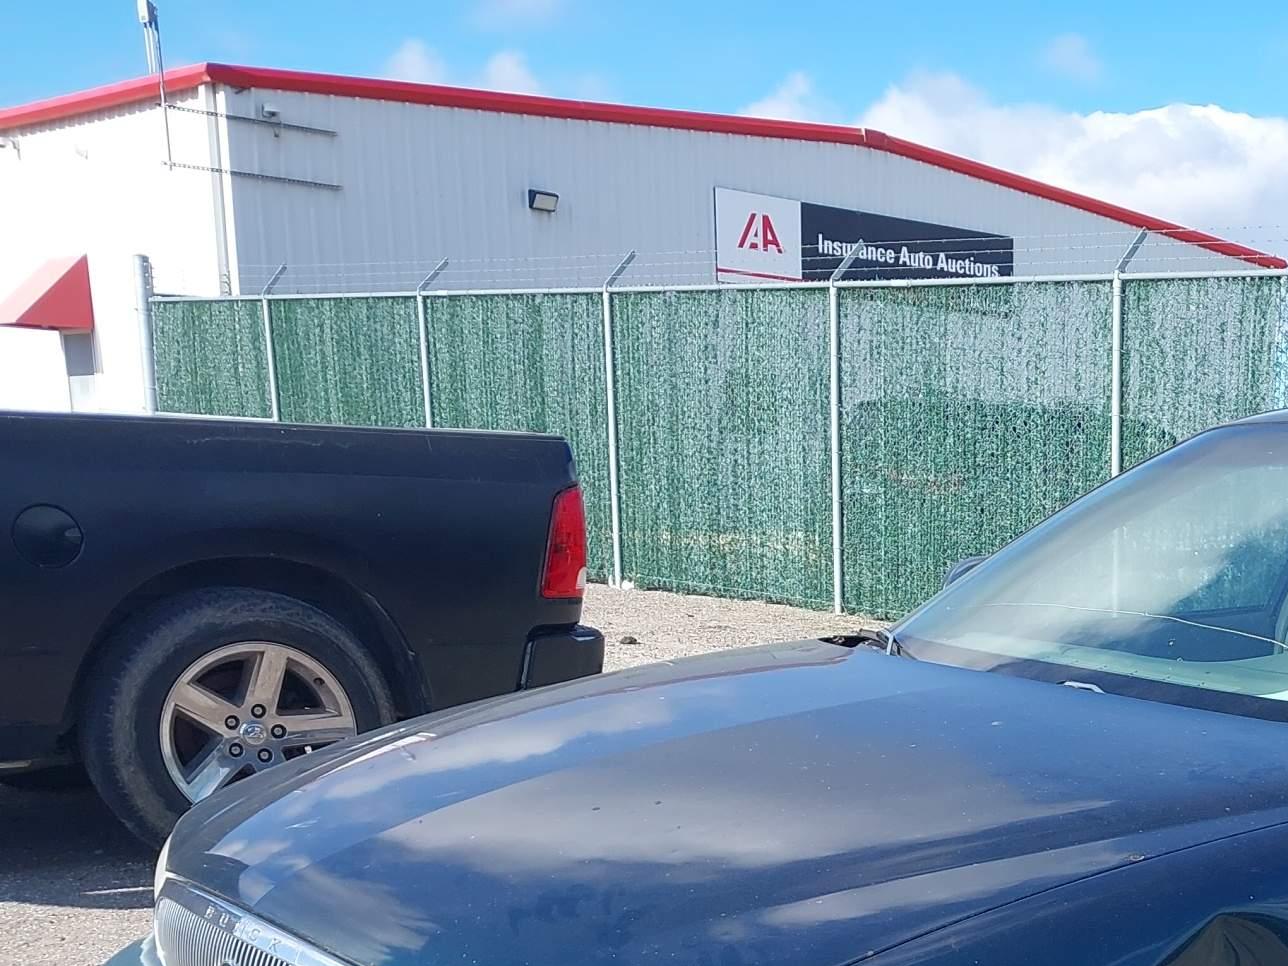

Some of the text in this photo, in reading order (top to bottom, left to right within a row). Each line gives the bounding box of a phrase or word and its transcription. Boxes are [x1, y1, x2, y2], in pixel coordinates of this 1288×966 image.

[898, 246, 933, 270] Auto
[936, 252, 1000, 278] Auctions
[204, 905, 282, 953] BUICK
